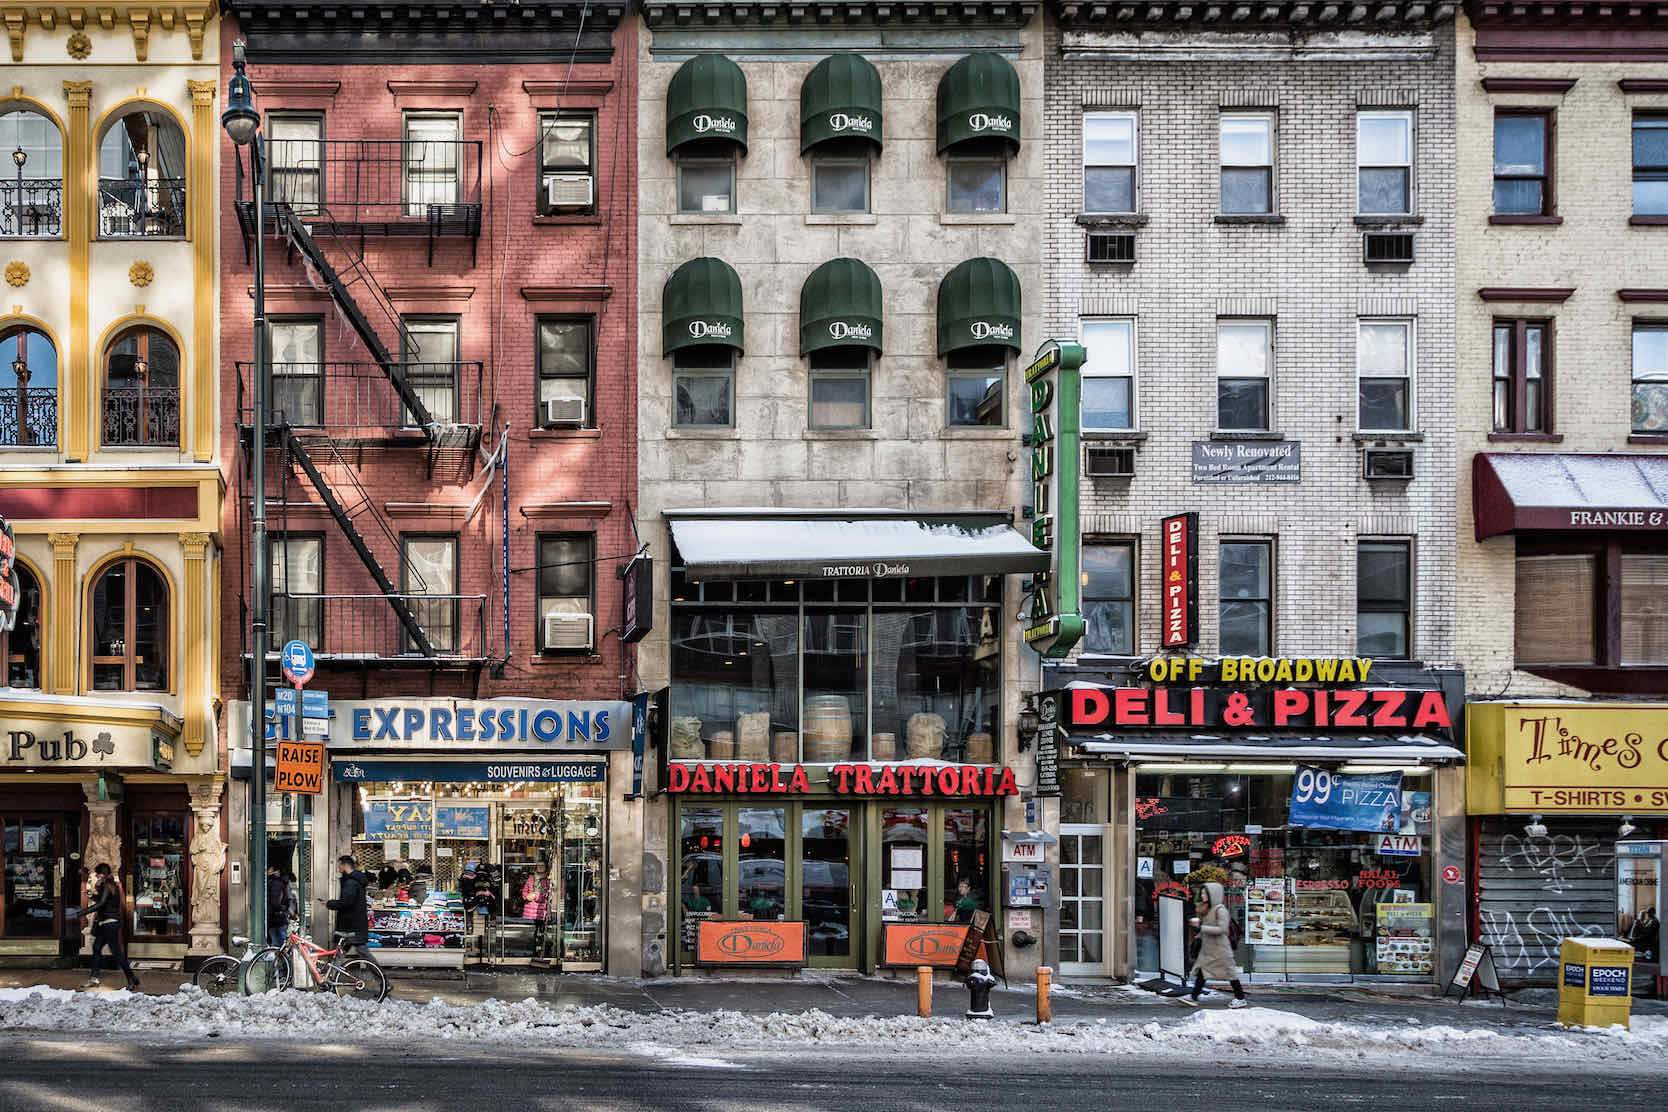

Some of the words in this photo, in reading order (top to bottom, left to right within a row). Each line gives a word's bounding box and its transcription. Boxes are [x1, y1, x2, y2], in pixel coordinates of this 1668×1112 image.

[693, 114, 736, 132] Daniela
[829, 113, 872, 132] Daniela
[969, 113, 1012, 131] Daniela
[689, 320, 732, 338] Daniela
[829, 321, 872, 339] Daniela
[970, 321, 1013, 339] Daniela
[1201, 445, 1234, 460] Newly
[1237, 445, 1292, 457] Renovated
[1570, 511, 1645, 526] FRANKIE
[1649, 511, 1663, 526] &
[1169, 521, 1183, 567] DELI
[822, 565, 870, 577] TRATTORIA
[872, 562, 910, 578] Daniela
[1169, 570, 1183, 582] &
[1169, 585, 1183, 642] PIZZA
[1149, 658, 1203, 682] OFF
[1220, 658, 1372, 682] BROADWAY
[1071, 688, 1205, 726] DELI
[1222, 692, 1256, 727] &
[1273, 688, 1453, 728] PIZZA
[352, 706, 610, 742] EXPRESSIONS
[8, 730, 88, 761] Pub
[1519, 716, 1643, 772] Times
[281, 748, 320, 763] RAISE
[279, 772, 319, 788] PLOW
[487, 765, 541, 778] SOUVENIRS
[551, 765, 598, 778] LUGGAGE
[668, 762, 810, 794] DANIELA
[833, 764, 1020, 796] TRATTORIA
[1342, 789, 1399, 808] PIZZA
[1530, 790, 1626, 806] T-SHIRTS
[1013, 844, 1036, 857] ATM
[1380, 835, 1420, 850] ATM
[1140, 860, 1151, 872] A
[1296, 880, 1349, 890] ESPRESSO
[885, 892, 895, 905] A
[1592, 968, 1626, 978] EPOCH
